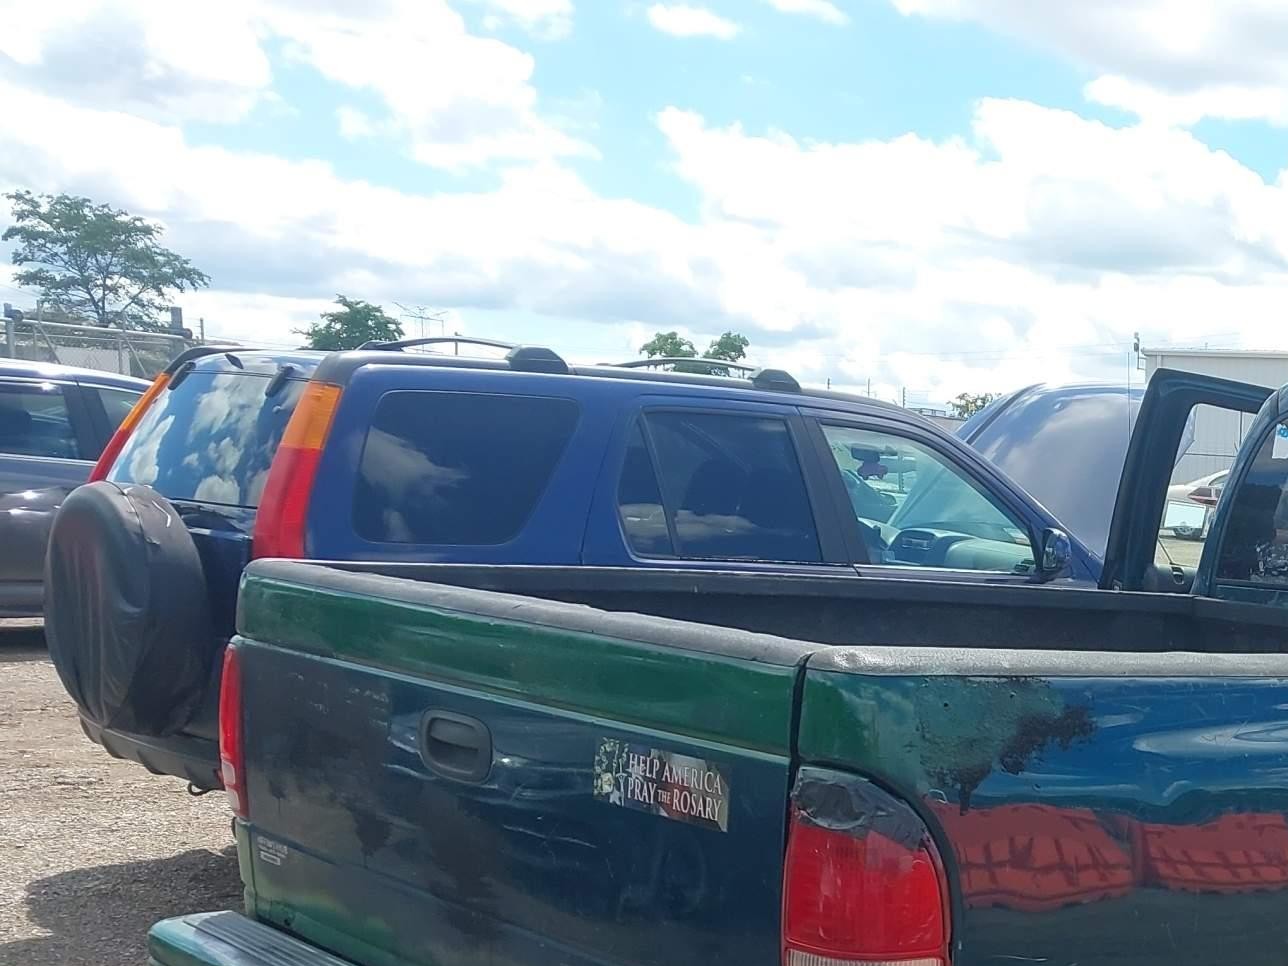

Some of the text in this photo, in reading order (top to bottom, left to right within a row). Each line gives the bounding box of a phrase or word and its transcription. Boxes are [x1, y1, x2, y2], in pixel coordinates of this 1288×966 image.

[628, 752, 722, 795] HELP AMERICA
[627, 776, 722, 822] PRAY THE ROSARY
